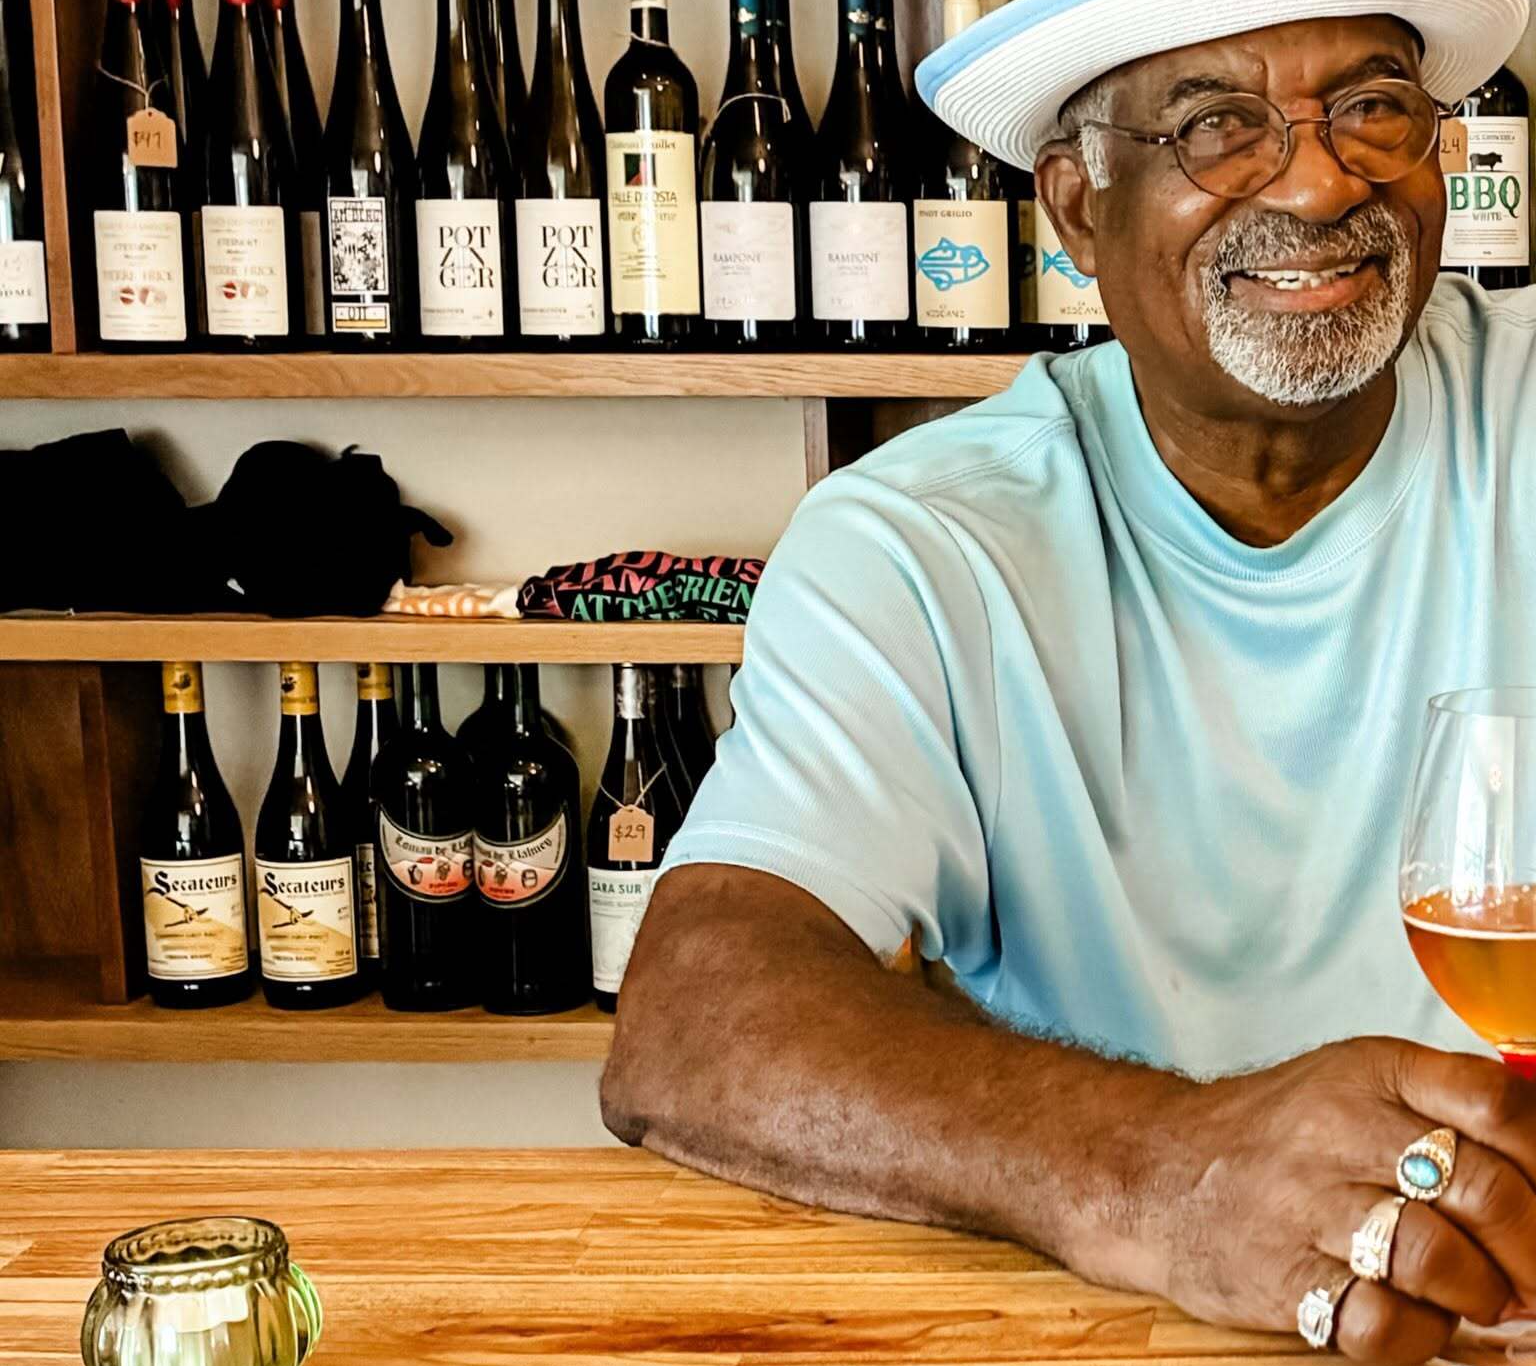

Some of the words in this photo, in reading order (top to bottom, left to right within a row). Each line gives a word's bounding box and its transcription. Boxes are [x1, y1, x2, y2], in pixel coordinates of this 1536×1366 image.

[1449, 174, 1524, 220] BBQ
[438, 225, 491, 249] POT
[541, 225, 594, 249] POT
[614, 823, 646, 843] $29
[153, 870, 238, 897] Secateurs
[263, 871, 345, 898] Secateurs
[618, 882, 643, 895] SUR
